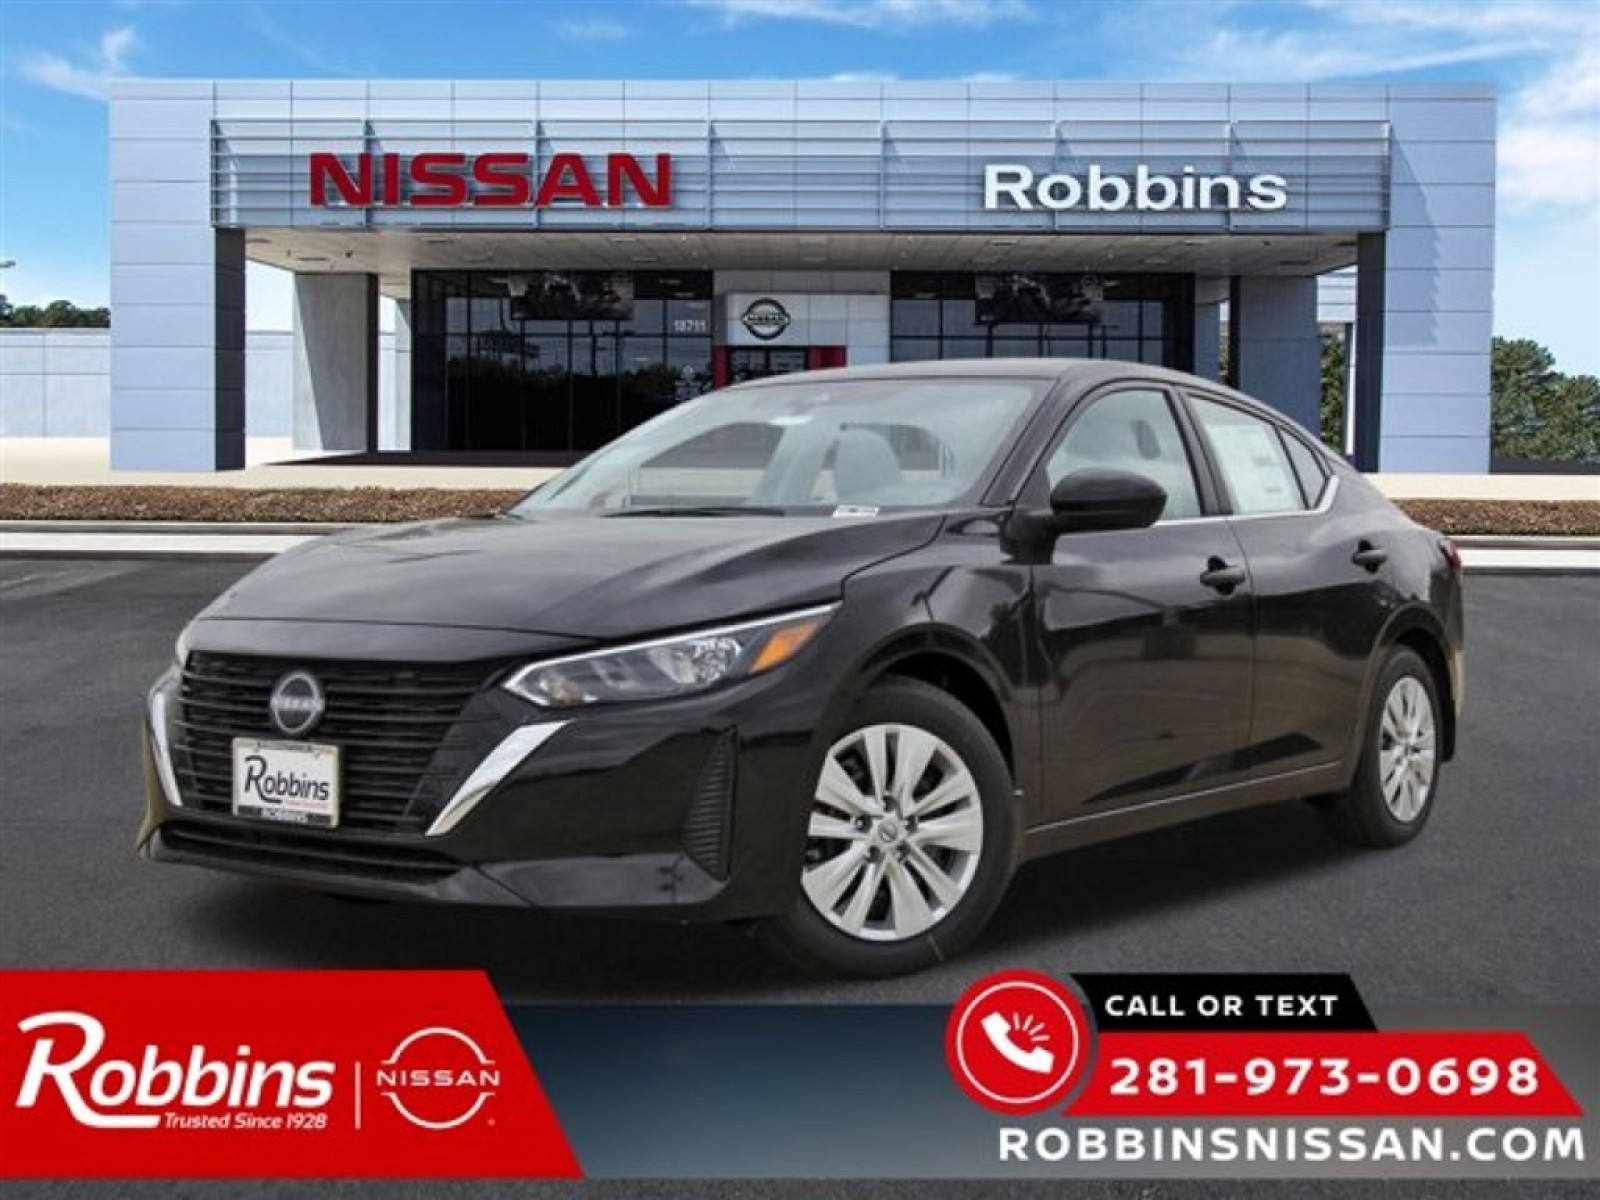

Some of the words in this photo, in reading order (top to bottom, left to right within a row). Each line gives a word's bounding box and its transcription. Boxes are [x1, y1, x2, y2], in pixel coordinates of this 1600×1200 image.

[309, 152, 671, 208] NISSAN
[984, 164, 1287, 210] Robbins
[244, 754, 329, 804] Robbins
